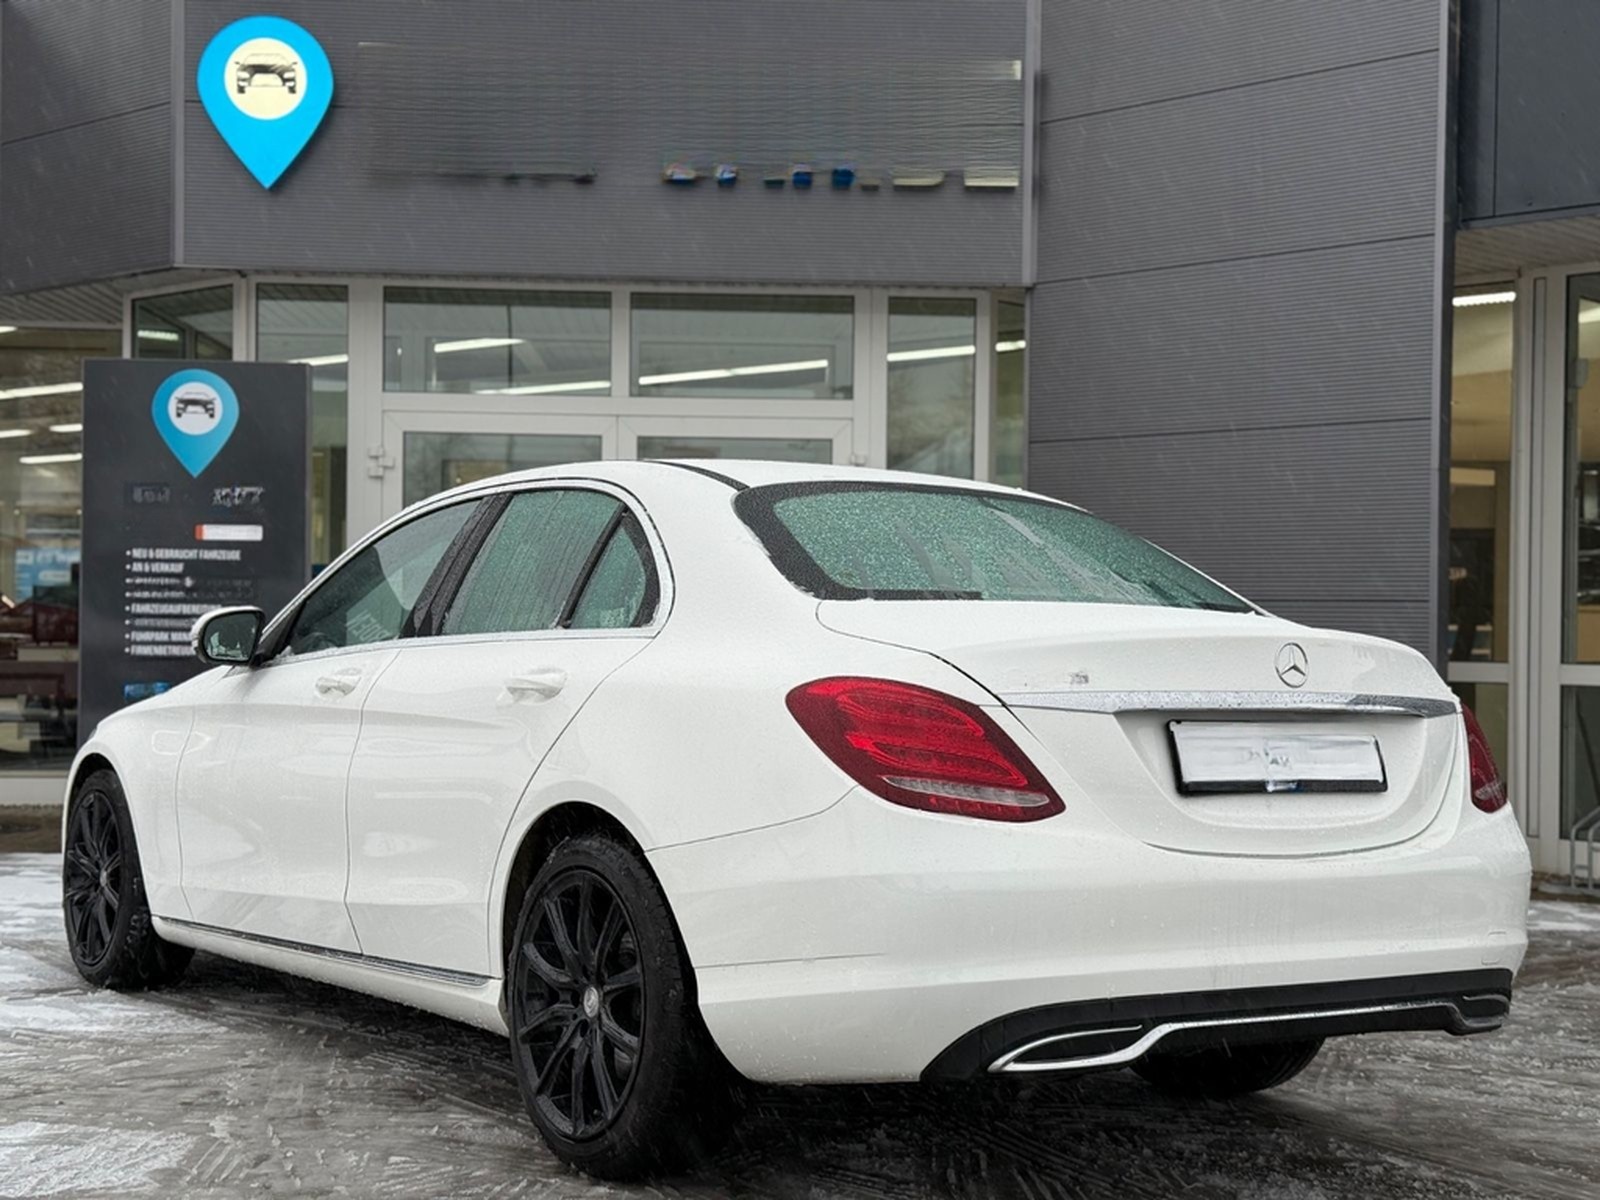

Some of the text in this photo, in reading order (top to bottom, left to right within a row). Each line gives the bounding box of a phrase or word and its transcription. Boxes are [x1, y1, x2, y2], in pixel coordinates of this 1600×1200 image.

[132, 547, 148, 559] NEU
[155, 548, 198, 560] GEBRAUCHT
[199, 549, 241, 561] FAHRZEUGE
[131, 562, 143, 573] AN
[151, 562, 184, 573] VERKAUF
